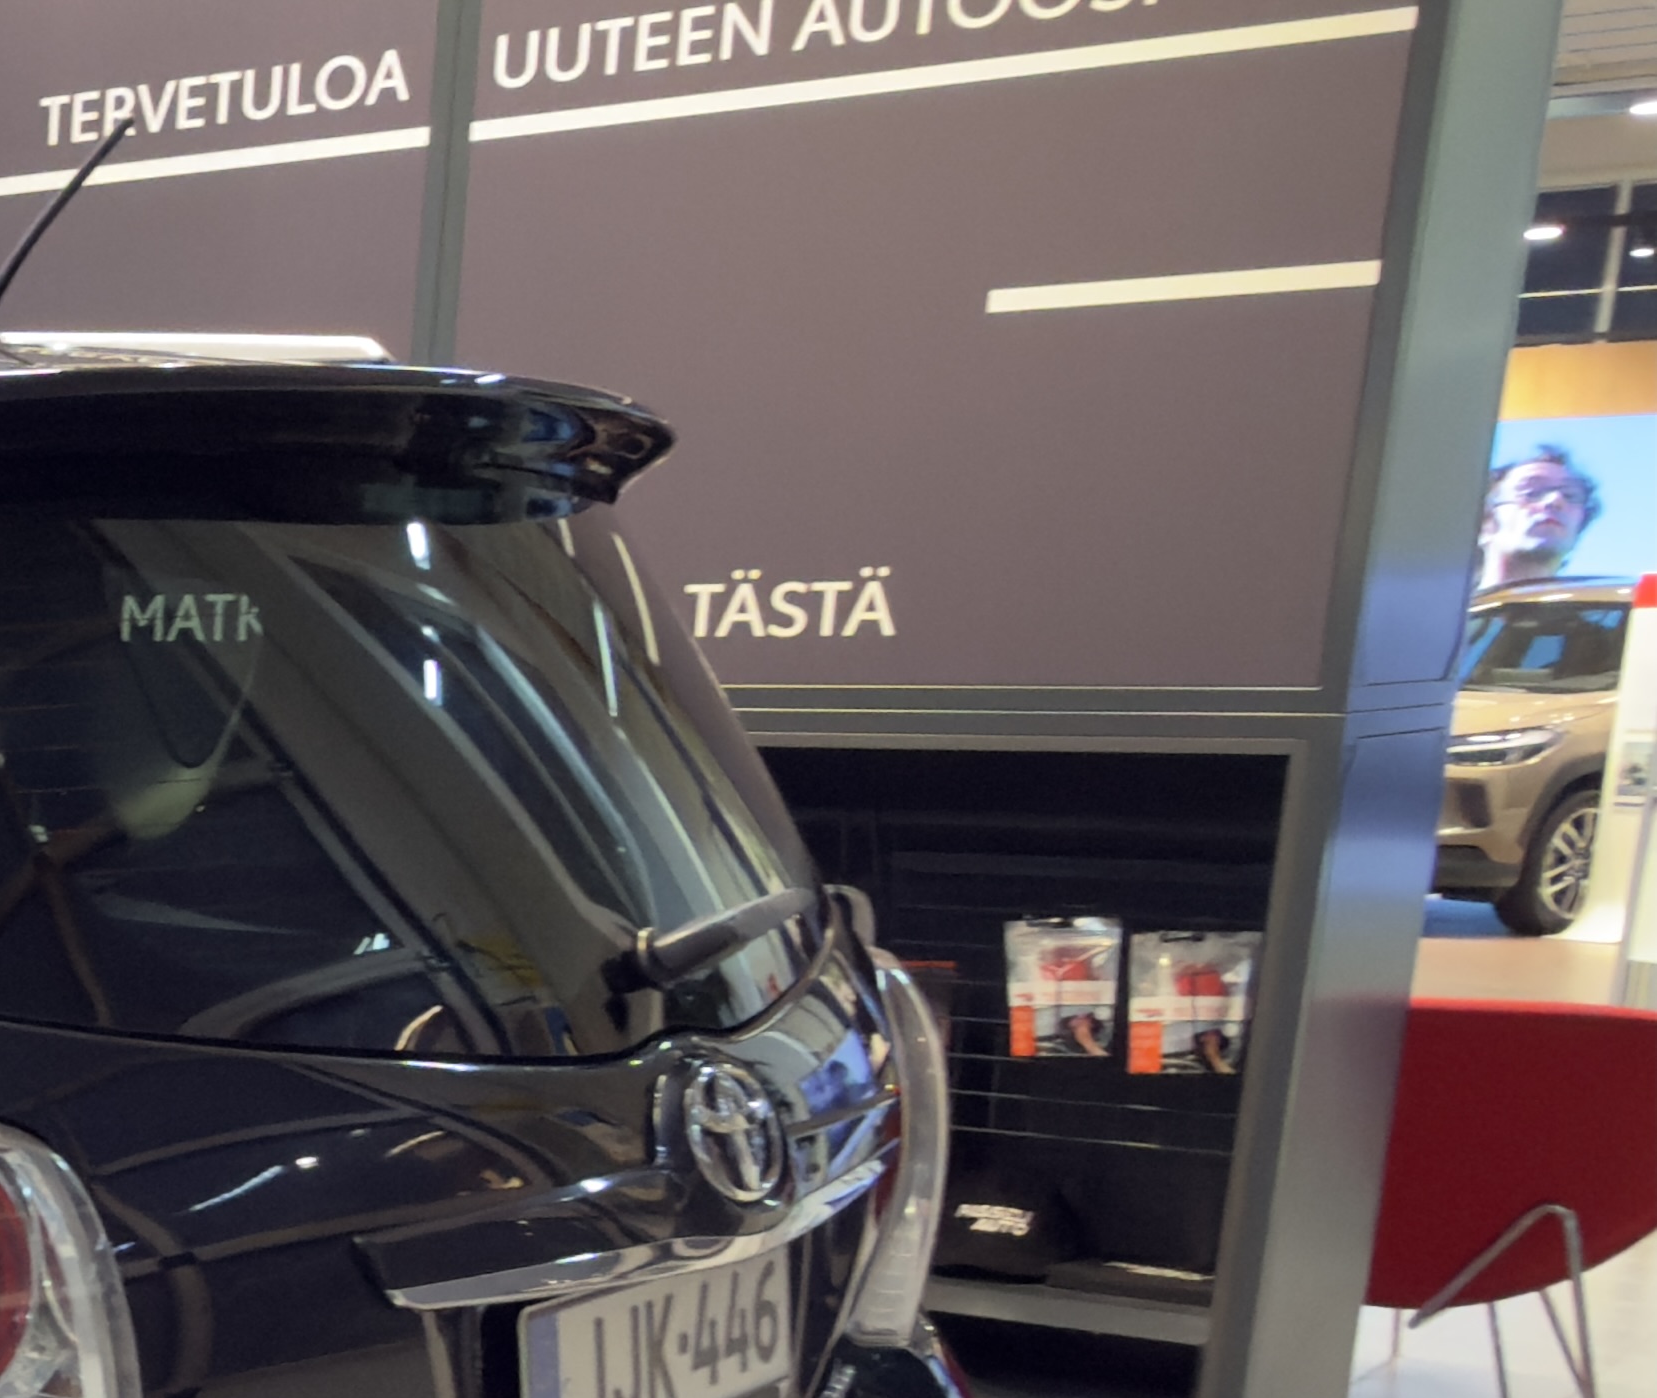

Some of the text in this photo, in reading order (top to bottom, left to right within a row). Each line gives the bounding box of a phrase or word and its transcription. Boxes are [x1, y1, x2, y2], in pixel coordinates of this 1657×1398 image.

[39, 48, 410, 147] TERVETULOA
[493, 0, 774, 89] UUTEEN
[683, 565, 896, 638] TÄSTÄ
